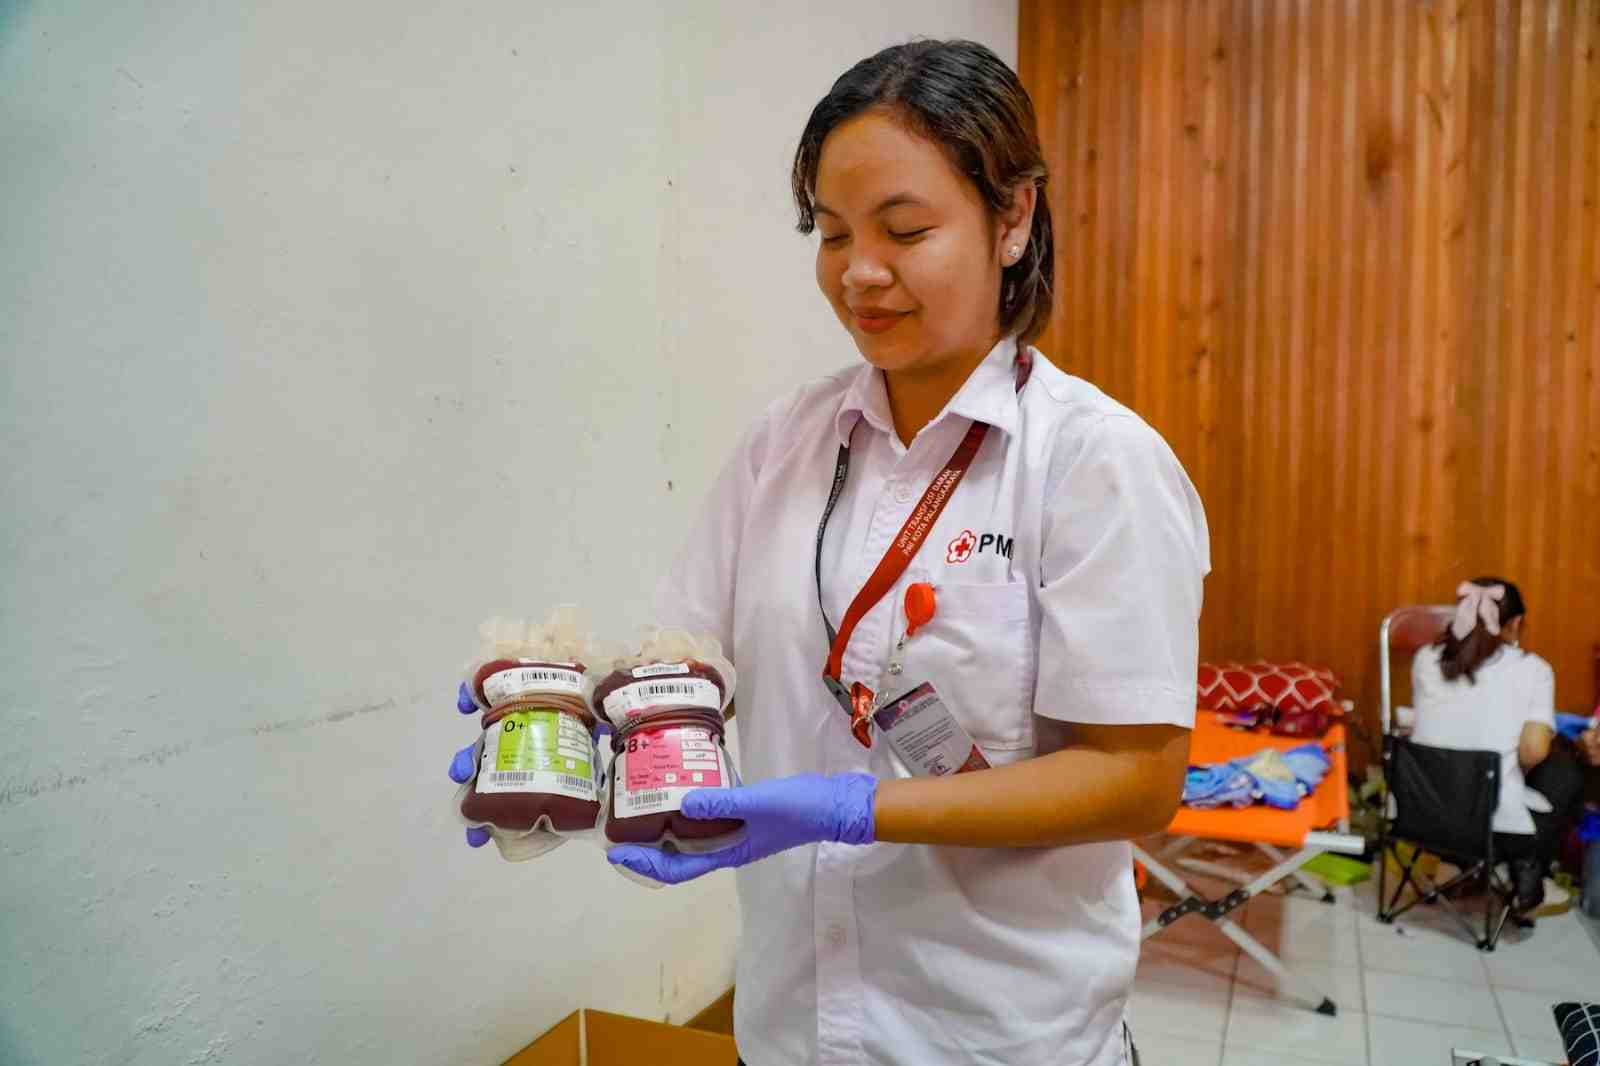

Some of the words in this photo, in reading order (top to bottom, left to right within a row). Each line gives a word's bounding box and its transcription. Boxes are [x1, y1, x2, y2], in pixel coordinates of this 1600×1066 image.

[897, 532, 911, 548] UNIT
[909, 491, 936, 530] TRANSFUSI
[932, 469, 951, 490] DARAH
[912, 522, 928, 541] KOTA
[978, 533, 1014, 560] PM
